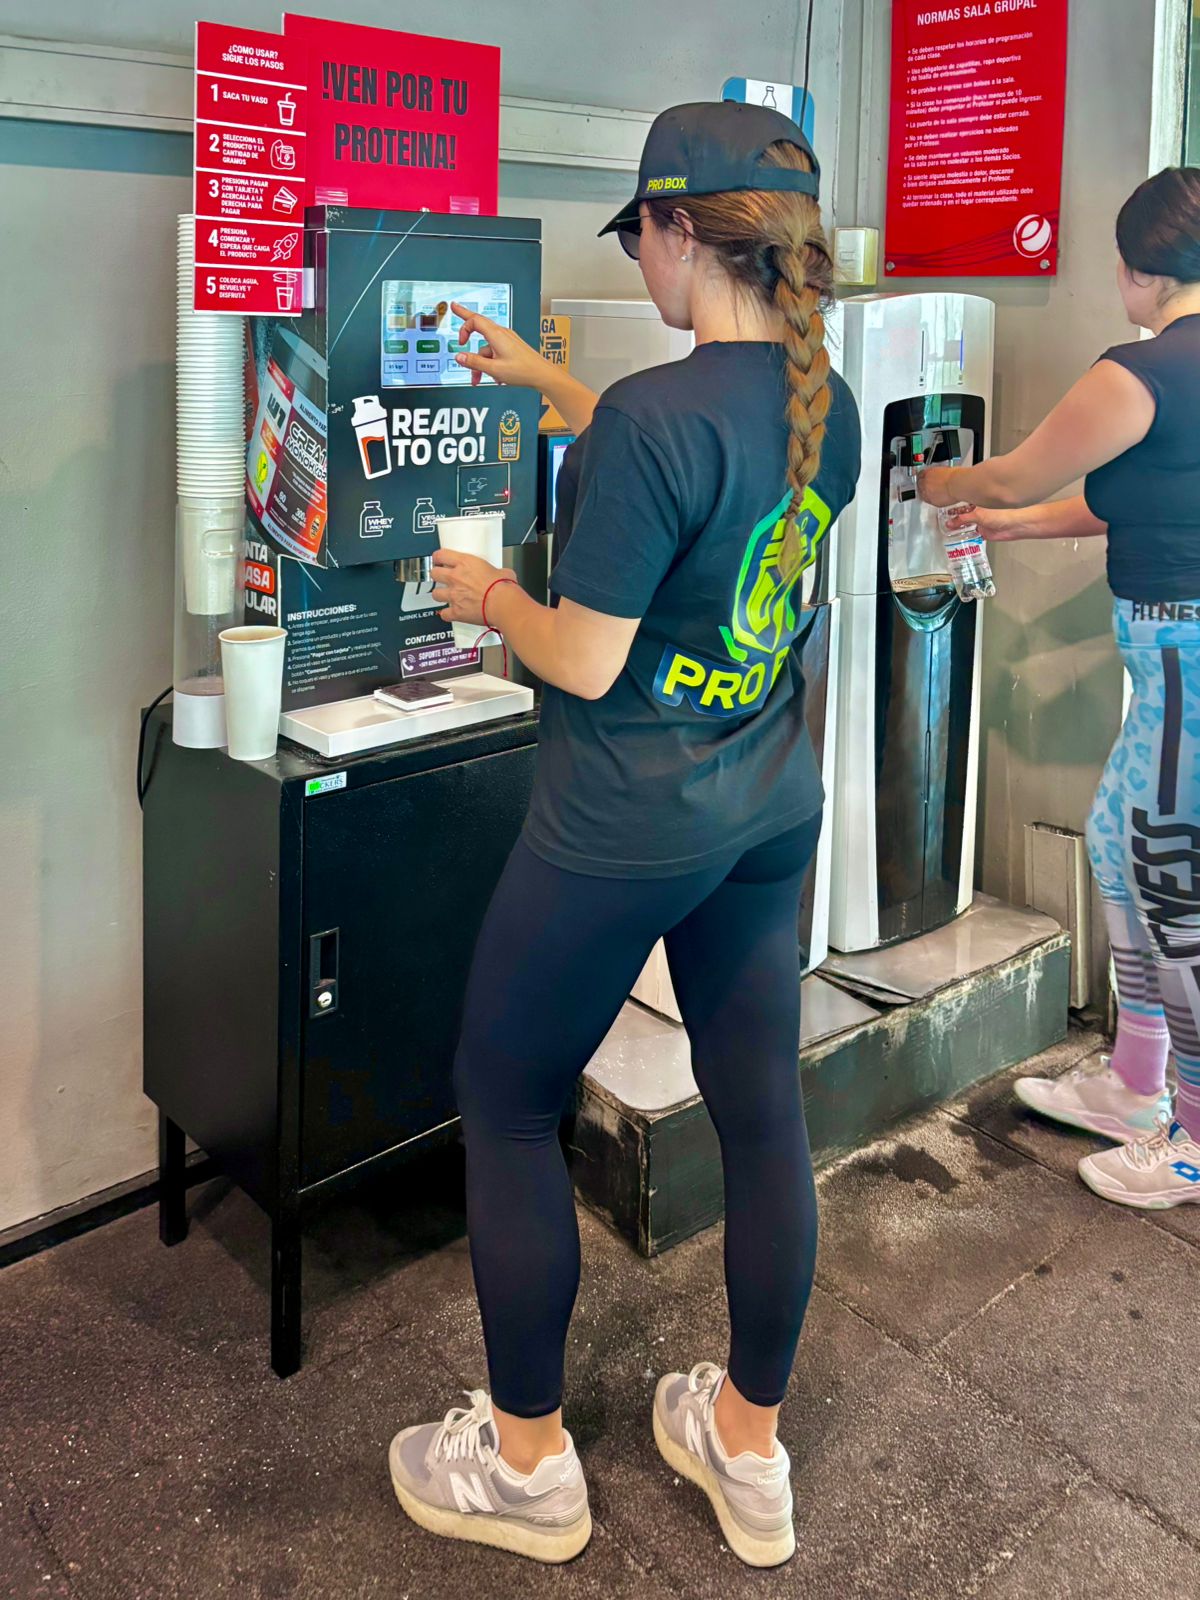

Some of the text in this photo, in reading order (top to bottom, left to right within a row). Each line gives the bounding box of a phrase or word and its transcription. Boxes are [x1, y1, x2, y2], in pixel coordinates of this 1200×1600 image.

[917, 0, 1037, 26] NORMAS SALA GRUPAL
[228, 44, 279, 60] ¿COMO USAR?
[222, 53, 284, 70] SIGUE LOS PASOS
[210, 84, 269, 104] 1 SACA TU VASO
[322, 62, 467, 115] !VEN POR TU
[209, 134, 219, 152] 2
[223, 134, 256, 144] SELECCIONA
[223, 141, 253, 151] PRODUCTO
[335, 124, 456, 169] PROTEINA!
[222, 149, 251, 159] CANTIDAD
[222, 157, 247, 166] GRAMOS
[209, 177, 269, 198] 3 PRESIONA PAGAR
[234, 186, 259, 194] TARJETA
[647, 177, 686, 191] PRO BOX
[221, 200, 263, 210] DERECHA PARA
[222, 192, 250, 201] ACERCALA
[208, 228, 248, 247] 4 PRESIONA
[220, 235, 250, 243] COMENZAR
[220, 242, 241, 250] ESPERA
[228, 251, 257, 259] PRODUCTO
[206, 276, 216, 294] 5
[392, 408, 489, 436] READY
[392, 438, 431, 466] TO
[438, 436, 485, 464] GO!
[288, 604, 357, 621] INSTRUCCIONES:
[405, 632, 445, 645] CONTACTO
[663, 653, 766, 709] PRO
